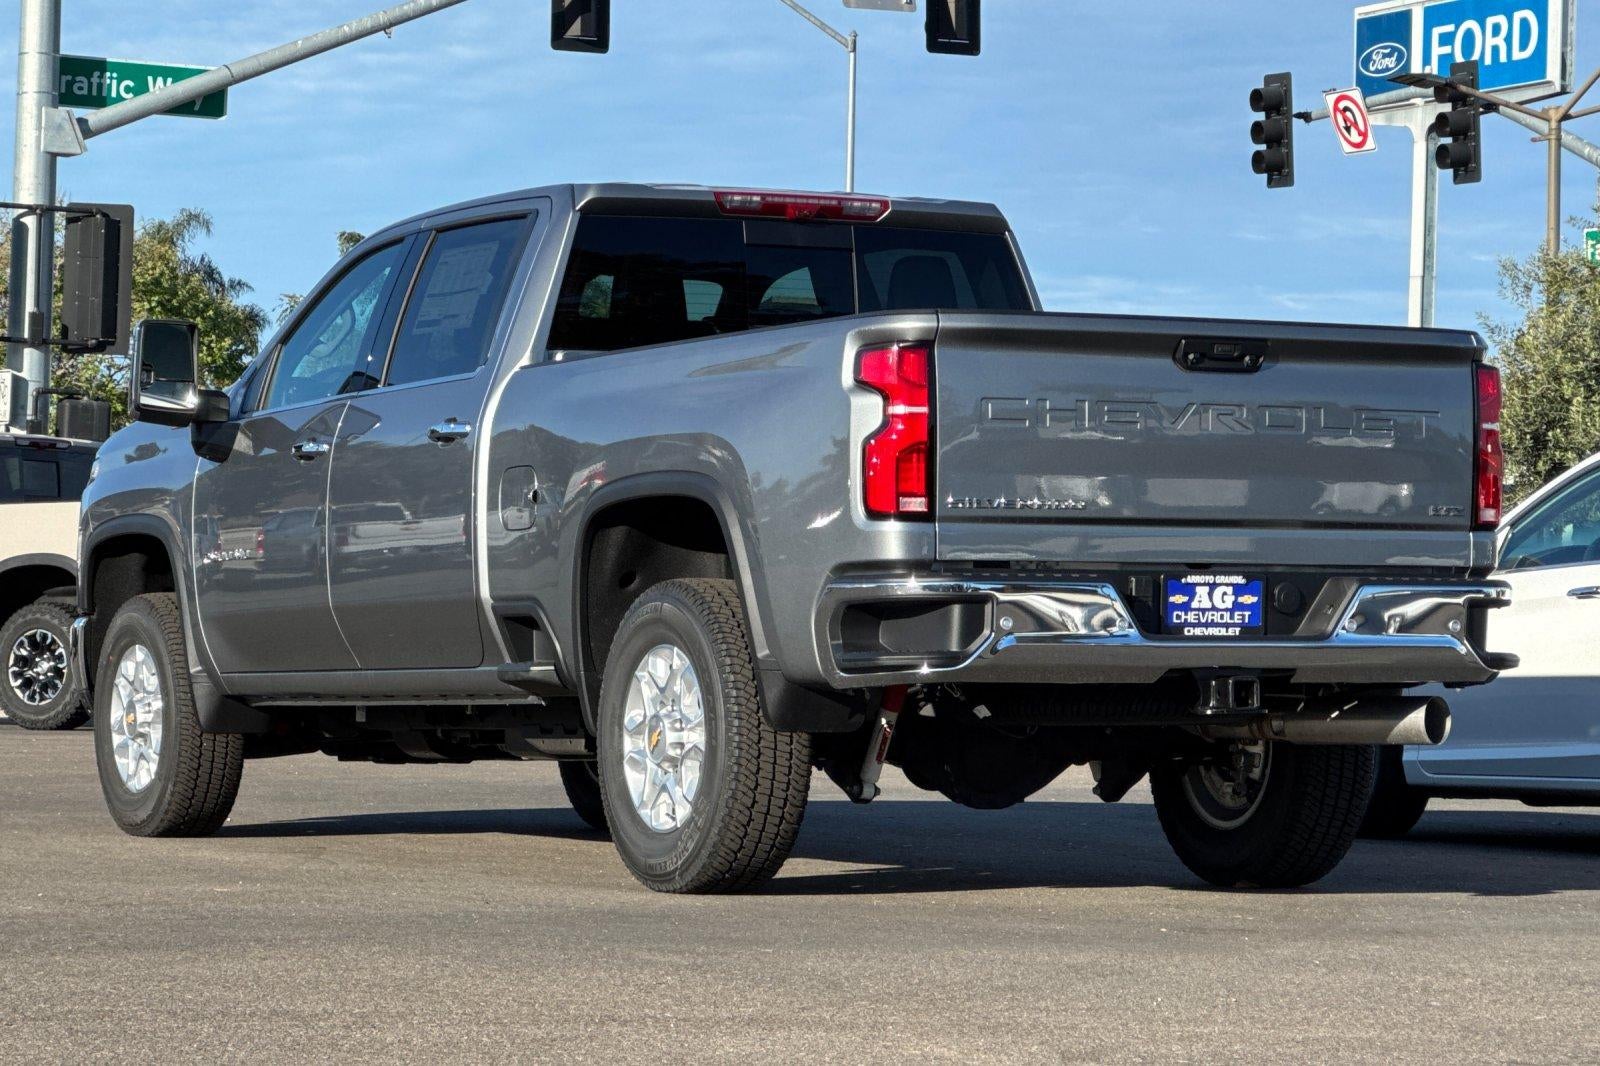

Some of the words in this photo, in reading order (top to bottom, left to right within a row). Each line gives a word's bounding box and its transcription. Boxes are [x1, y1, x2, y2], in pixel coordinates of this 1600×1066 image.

[1431, 9, 1539, 75] FORD
[1369, 48, 1397, 71] Ford
[60, 71, 135, 99] raffic
[980, 397, 1440, 441] CHEVROLET
[1186, 575, 1214, 584] ARROYO
[1215, 575, 1243, 584] GRANDE
[1191, 585, 1235, 609] AG
[1173, 611, 1251, 623] CHEVROLET
[1184, 627, 1241, 636] CHEVROLET
